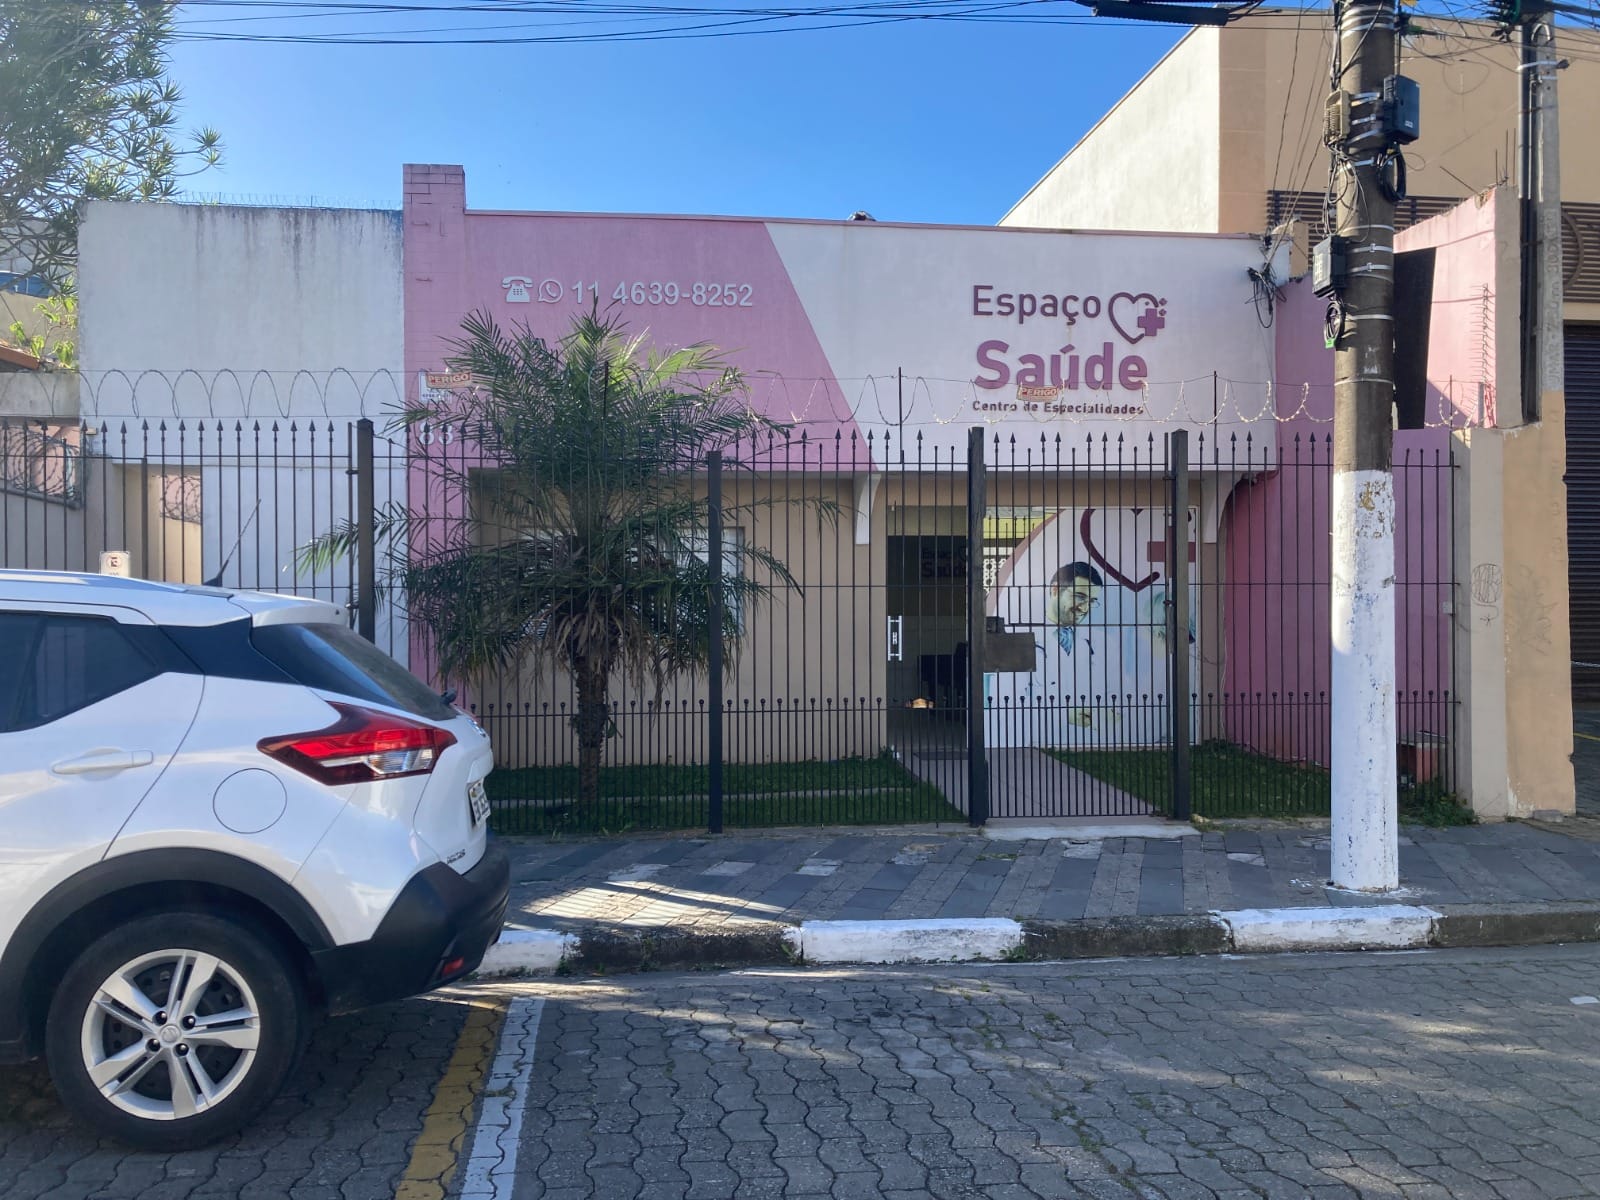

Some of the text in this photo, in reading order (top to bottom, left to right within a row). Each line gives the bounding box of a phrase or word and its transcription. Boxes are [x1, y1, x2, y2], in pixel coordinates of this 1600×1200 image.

[571, 280, 753, 307] 11 4639-8252
[973, 285, 1101, 326] Espaço
[974, 340, 1148, 390] Saúde
[1021, 387, 1057, 396] PERIGO
[972, 400, 1144, 415] Centro de Especialidades
